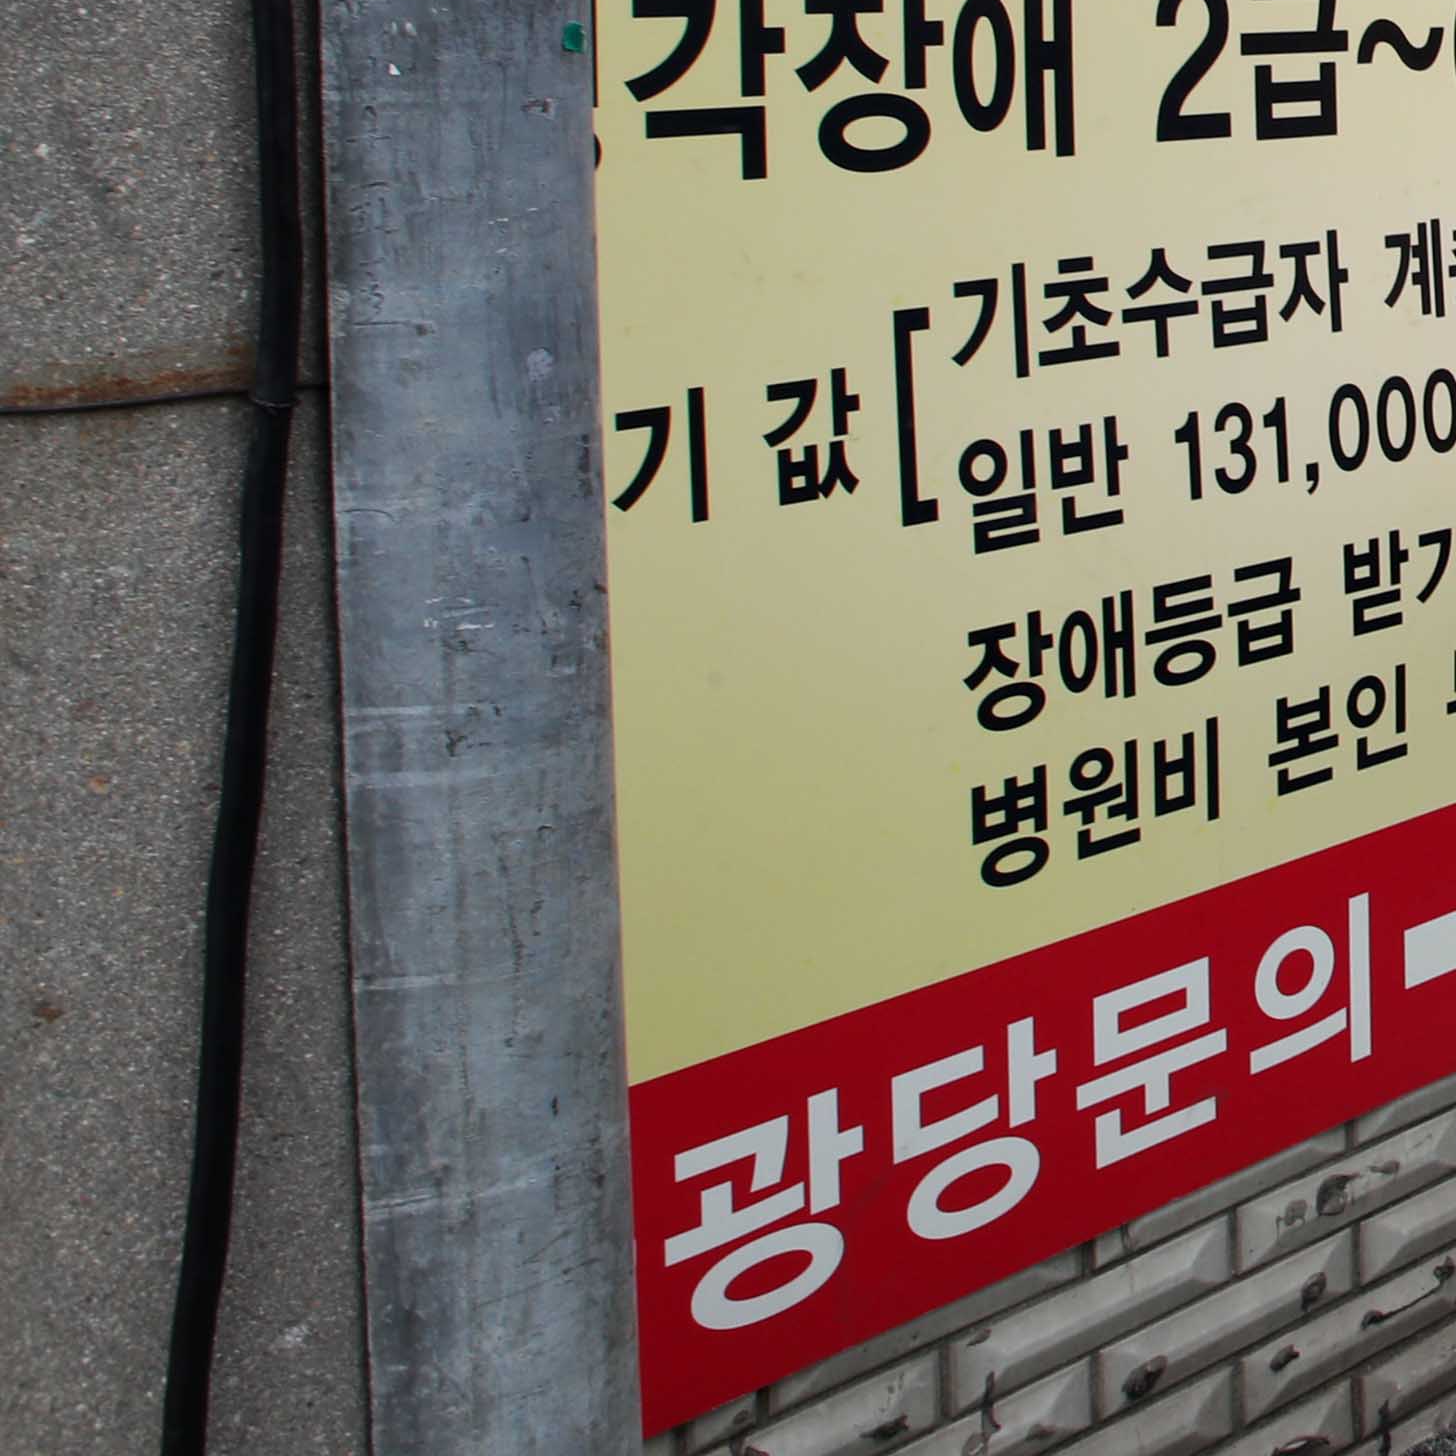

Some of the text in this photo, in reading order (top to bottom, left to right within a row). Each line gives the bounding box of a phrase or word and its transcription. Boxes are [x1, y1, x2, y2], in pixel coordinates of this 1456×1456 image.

[951, 228, 1349, 379] 기초수급자
[762, 366, 861, 508] 값
[957, 414, 1130, 556] 일반
[962, 554, 1298, 734] 장애등급
[970, 724, 1223, 887] 병원비
[1266, 660, 1409, 798] 본인
[662, 892, 1372, 1332] 광당문의
